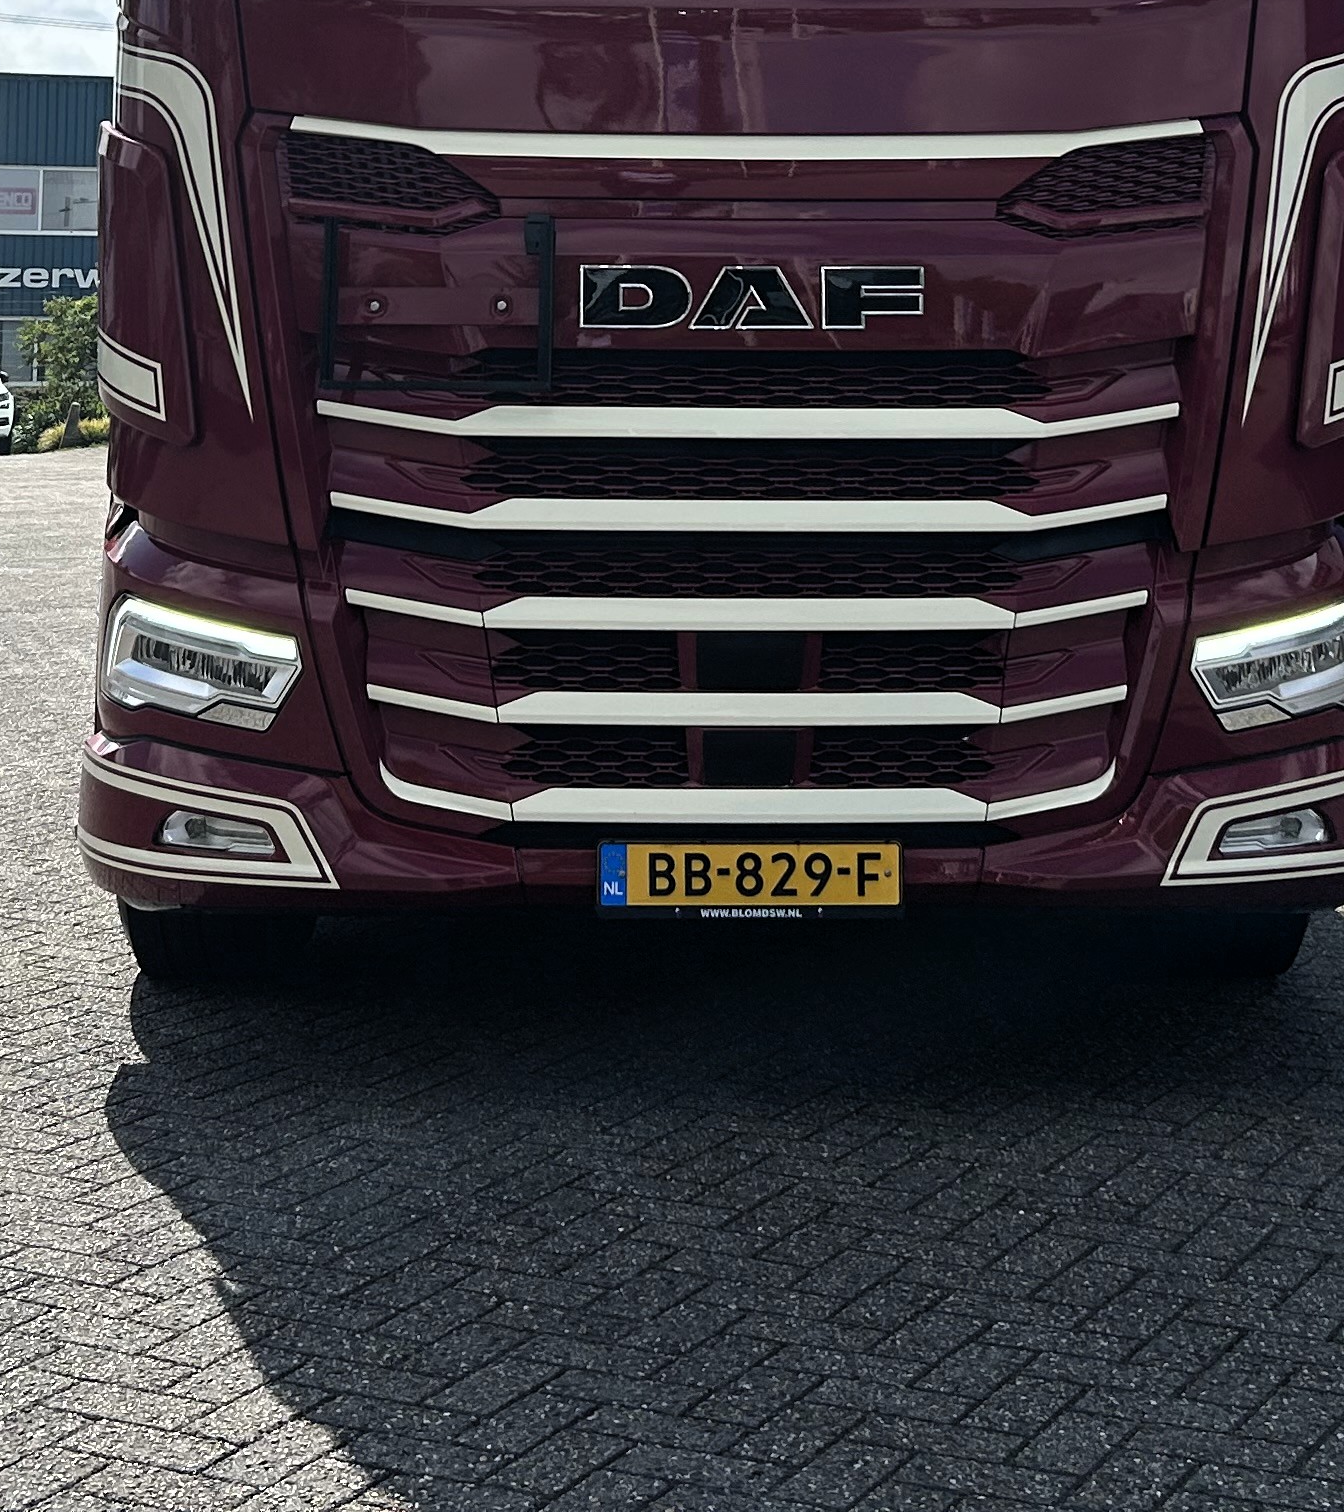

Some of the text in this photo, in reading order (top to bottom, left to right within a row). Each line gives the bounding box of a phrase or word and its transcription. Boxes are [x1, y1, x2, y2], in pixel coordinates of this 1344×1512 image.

[579, 264, 925, 330] DAF
[603, 852, 882, 897] NL BB-829-F
